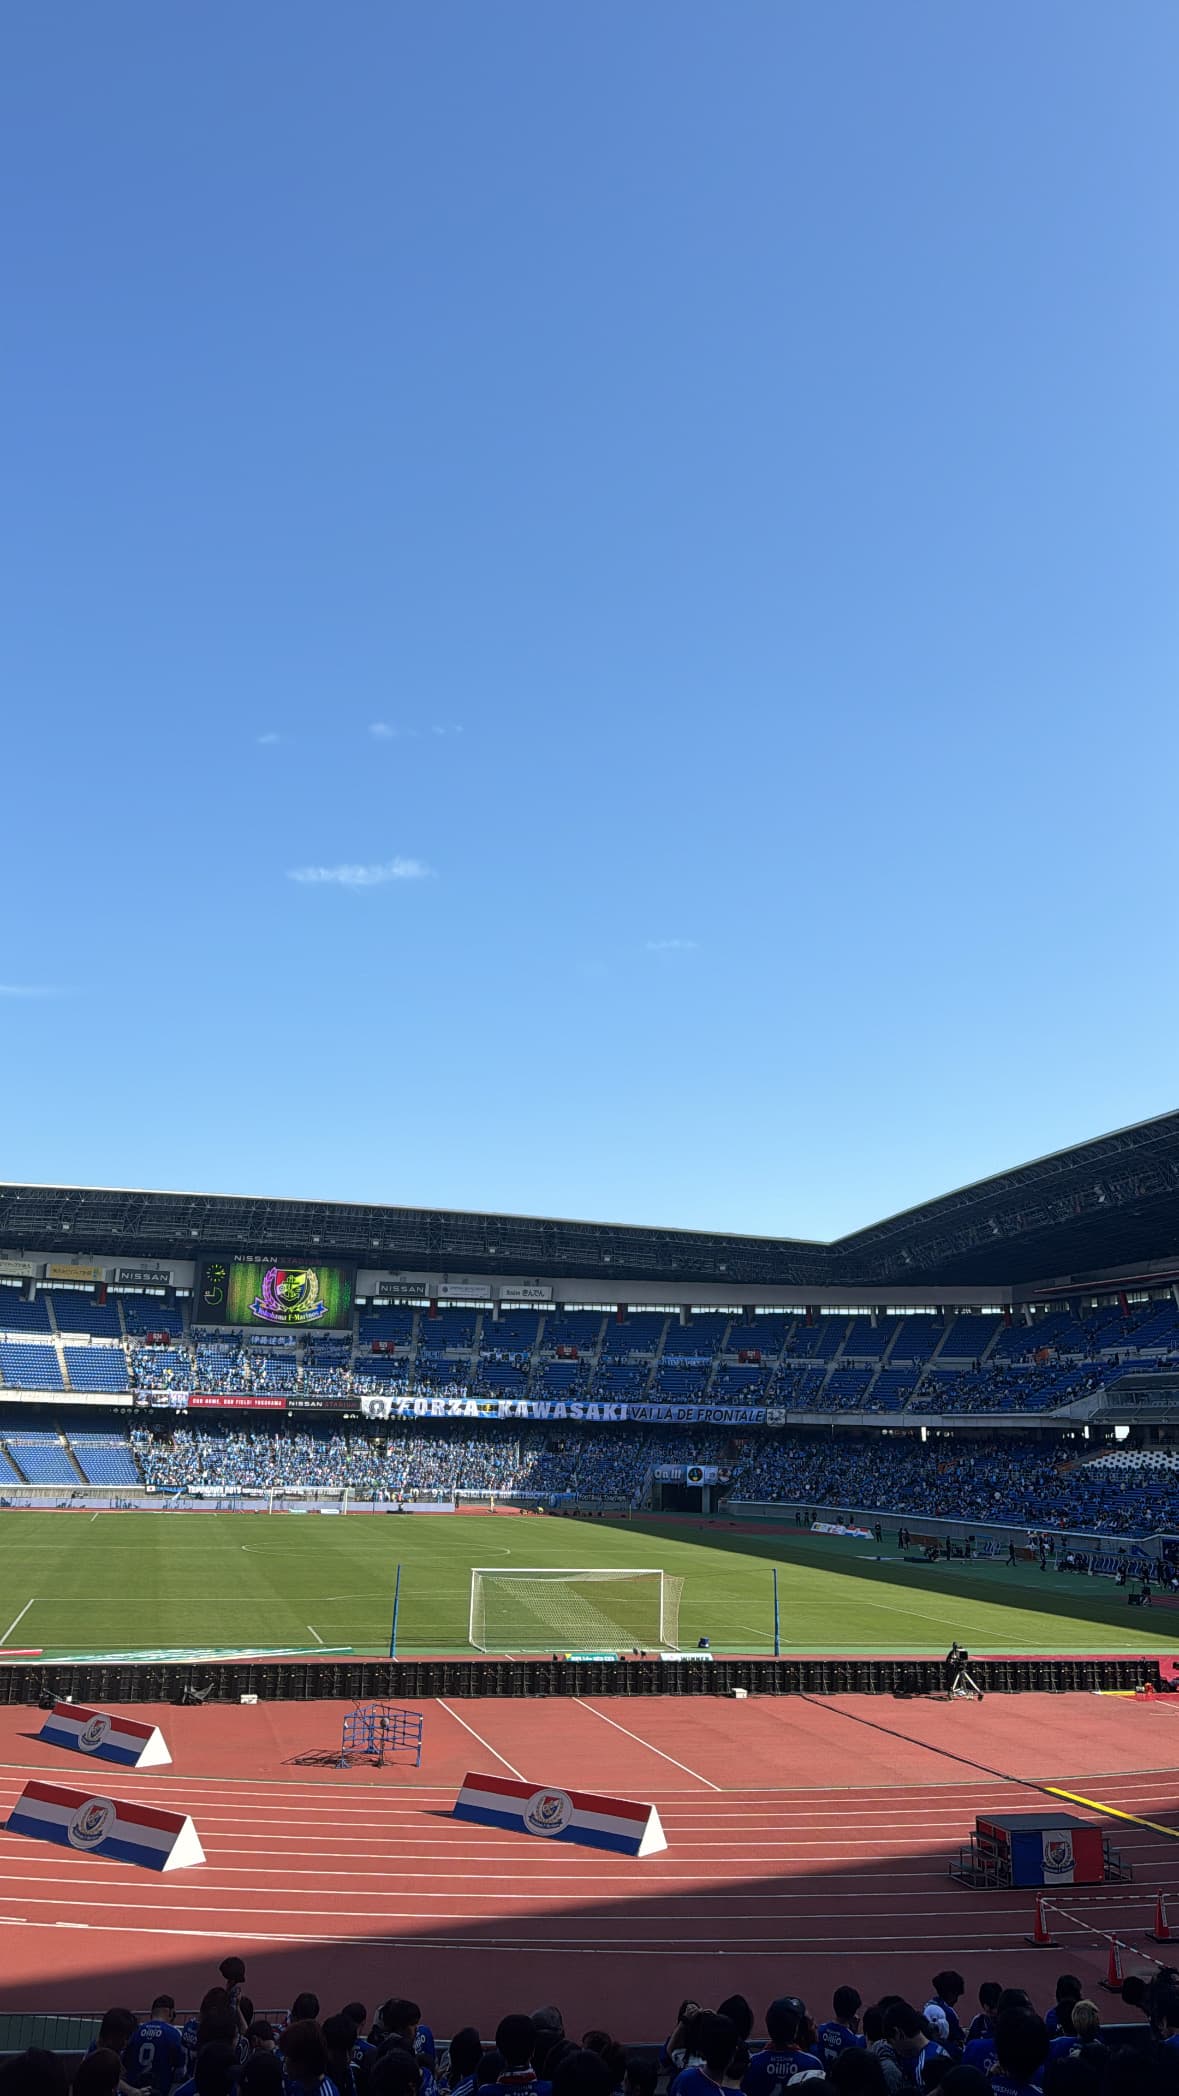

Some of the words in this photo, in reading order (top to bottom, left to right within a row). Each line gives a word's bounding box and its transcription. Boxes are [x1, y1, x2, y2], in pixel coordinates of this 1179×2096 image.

[233, 1255, 278, 1264] NISSAN
[120, 1271, 170, 1282] NISSAN
[380, 1285, 425, 1294] NISSAN
[289, 1400, 323, 1408] NISSAN
[397, 1397, 479, 1417] FORZA
[498, 1400, 628, 1421] KAWASAKI
[631, 1407, 653, 1420] VAI
[677, 1408, 694, 1421] DE
[697, 1408, 764, 1423] FRONTALE
